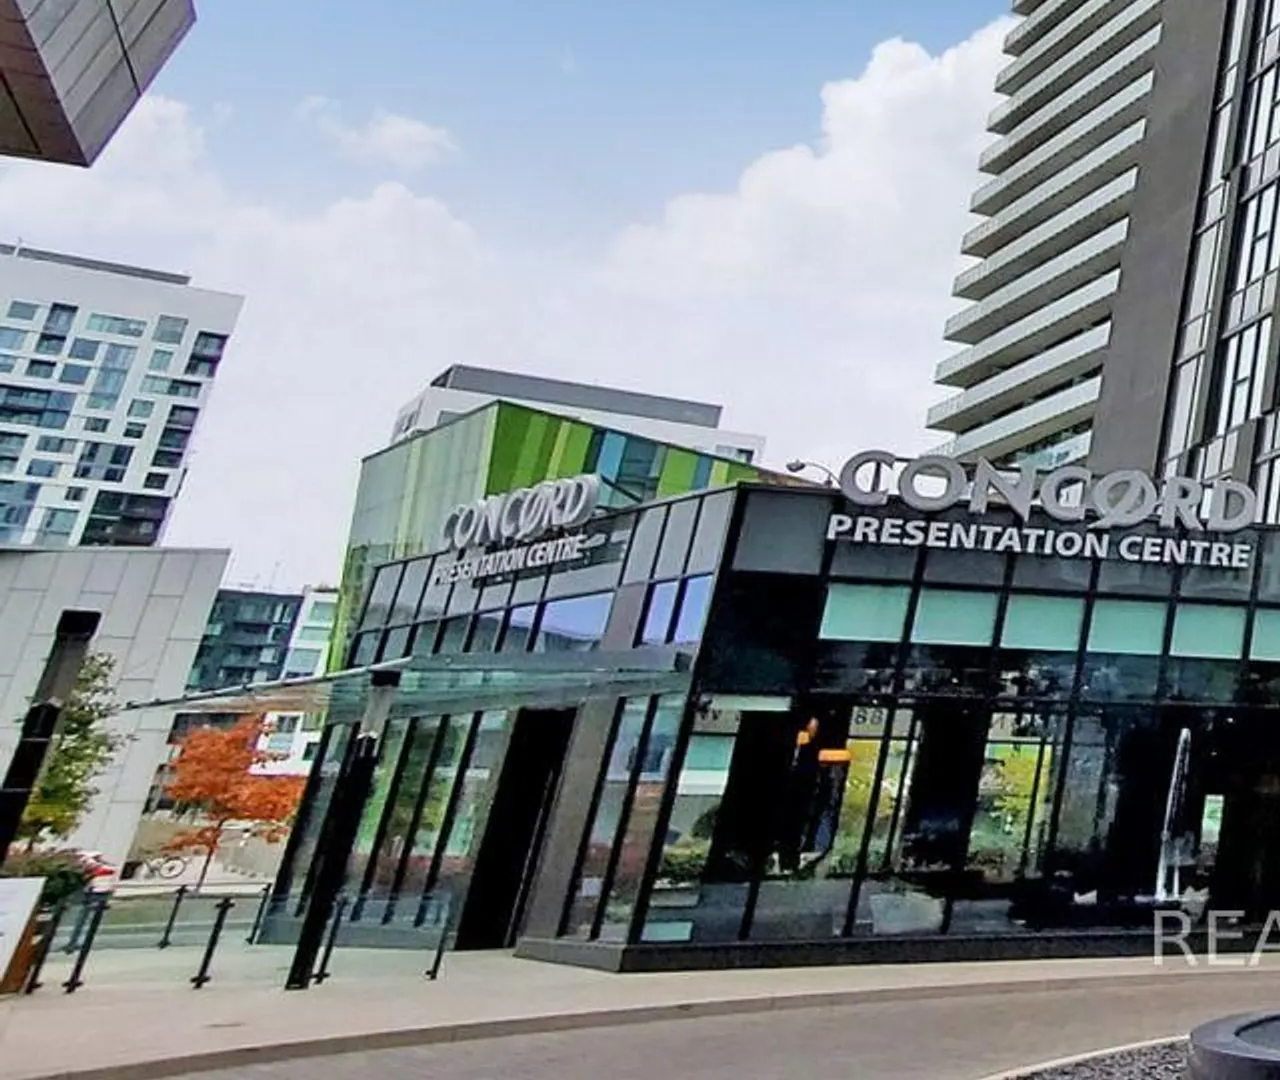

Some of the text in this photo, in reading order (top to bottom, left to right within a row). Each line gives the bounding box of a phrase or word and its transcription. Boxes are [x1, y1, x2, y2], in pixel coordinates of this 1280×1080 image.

[840, 450, 1257, 533] CONCORD
[526, 533, 587, 568] CENTRE
[827, 514, 1253, 568] PRESENTATION CENTRE
